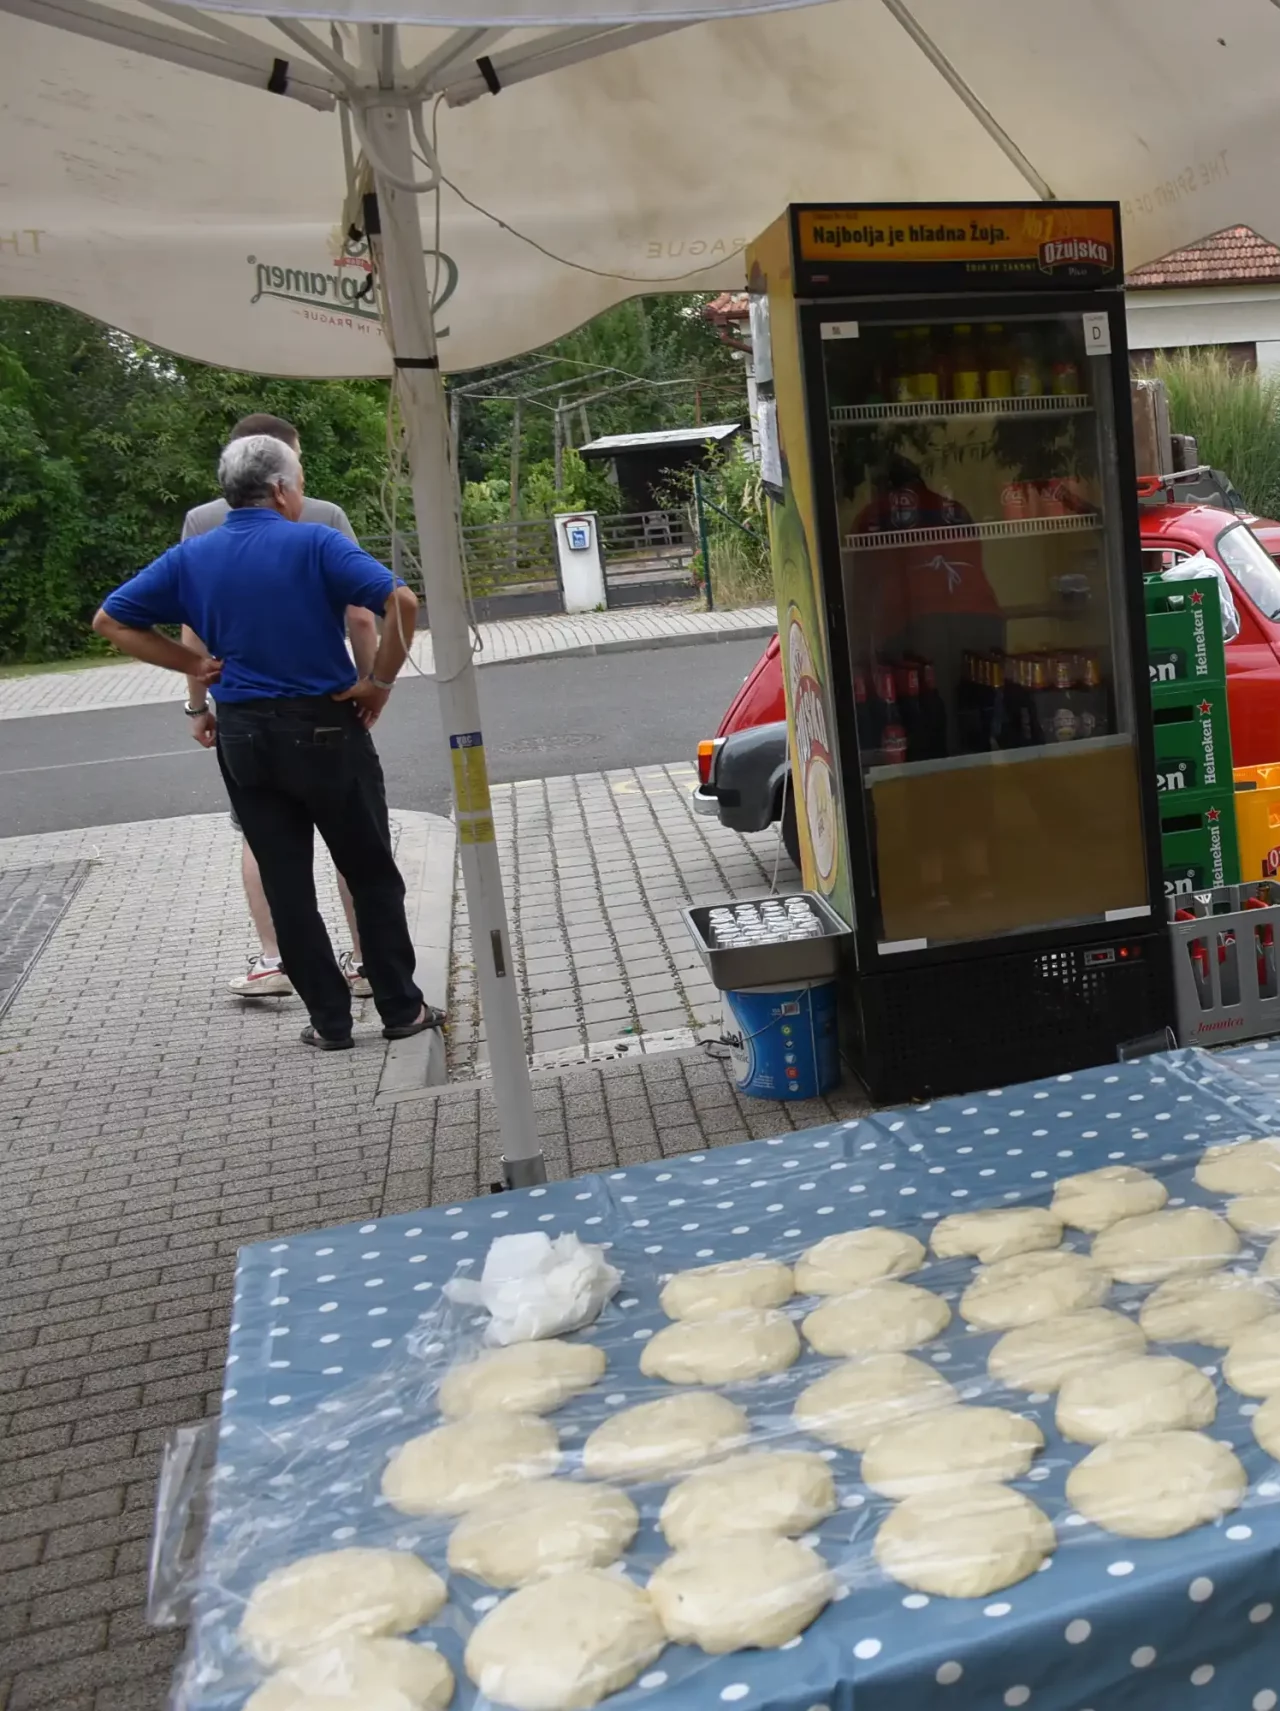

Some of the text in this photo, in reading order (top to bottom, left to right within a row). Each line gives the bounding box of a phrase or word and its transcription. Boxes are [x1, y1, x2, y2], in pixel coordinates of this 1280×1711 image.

[812, 220, 1011, 248] Najbolja je hladna Žuja.
[1044, 238, 1108, 264] Ožujsko
[1092, 326, 1102, 340] D
[1193, 608, 1208, 676] Heineken
[1202, 718, 1217, 785] Heineken
[1210, 826, 1225, 889] Heineken
